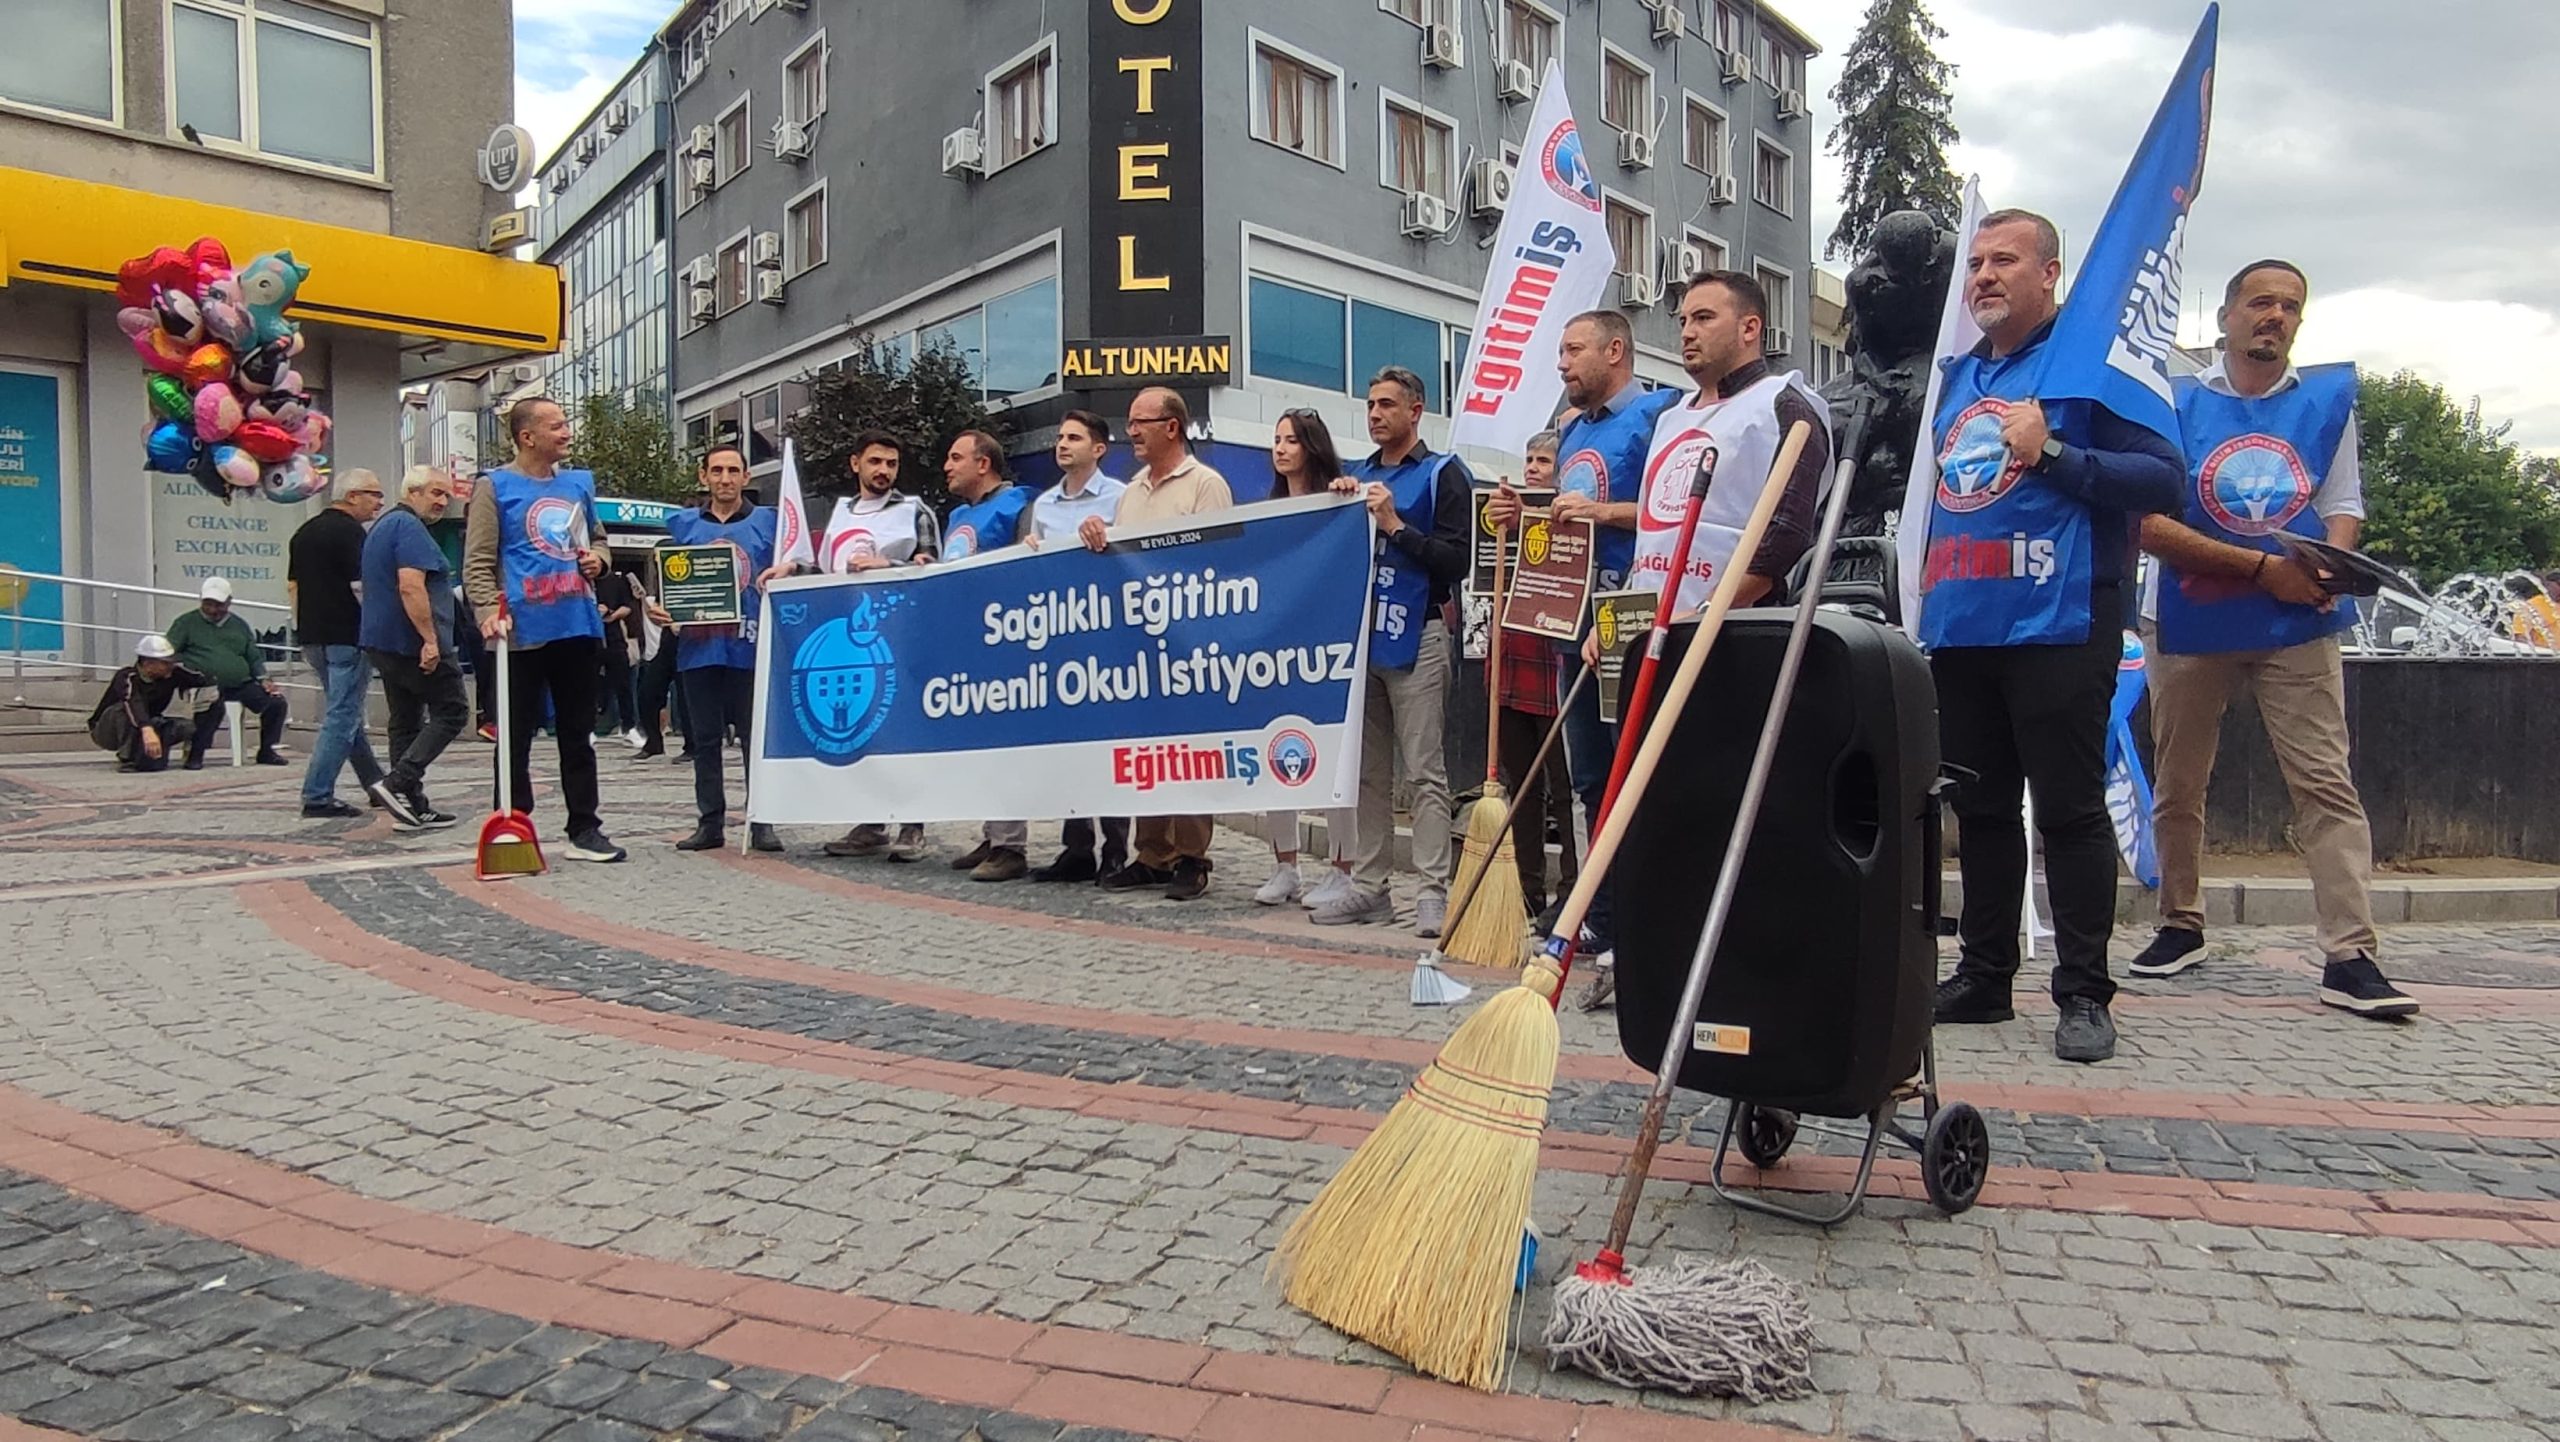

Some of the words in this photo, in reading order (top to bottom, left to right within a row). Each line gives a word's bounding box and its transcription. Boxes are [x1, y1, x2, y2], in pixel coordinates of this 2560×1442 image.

[491, 143, 516, 167] UPT
[1063, 345, 1229, 376] ALTUNHAN
[187, 515, 268, 532] CHANGE
[175, 540, 281, 557] EXCHANGE
[1151, 534, 1179, 548] EYLÜL
[1180, 532, 1201, 544] 2024
[182, 565, 275, 580] WECHSEL
[984, 583, 1112, 651] Sağlıklı
[1123, 567, 1259, 636] Eğitim
[922, 661, 1048, 719] Güvenli
[1056, 650, 1149, 705] Okul
[1157, 639, 1355, 704] İstiyoruz
